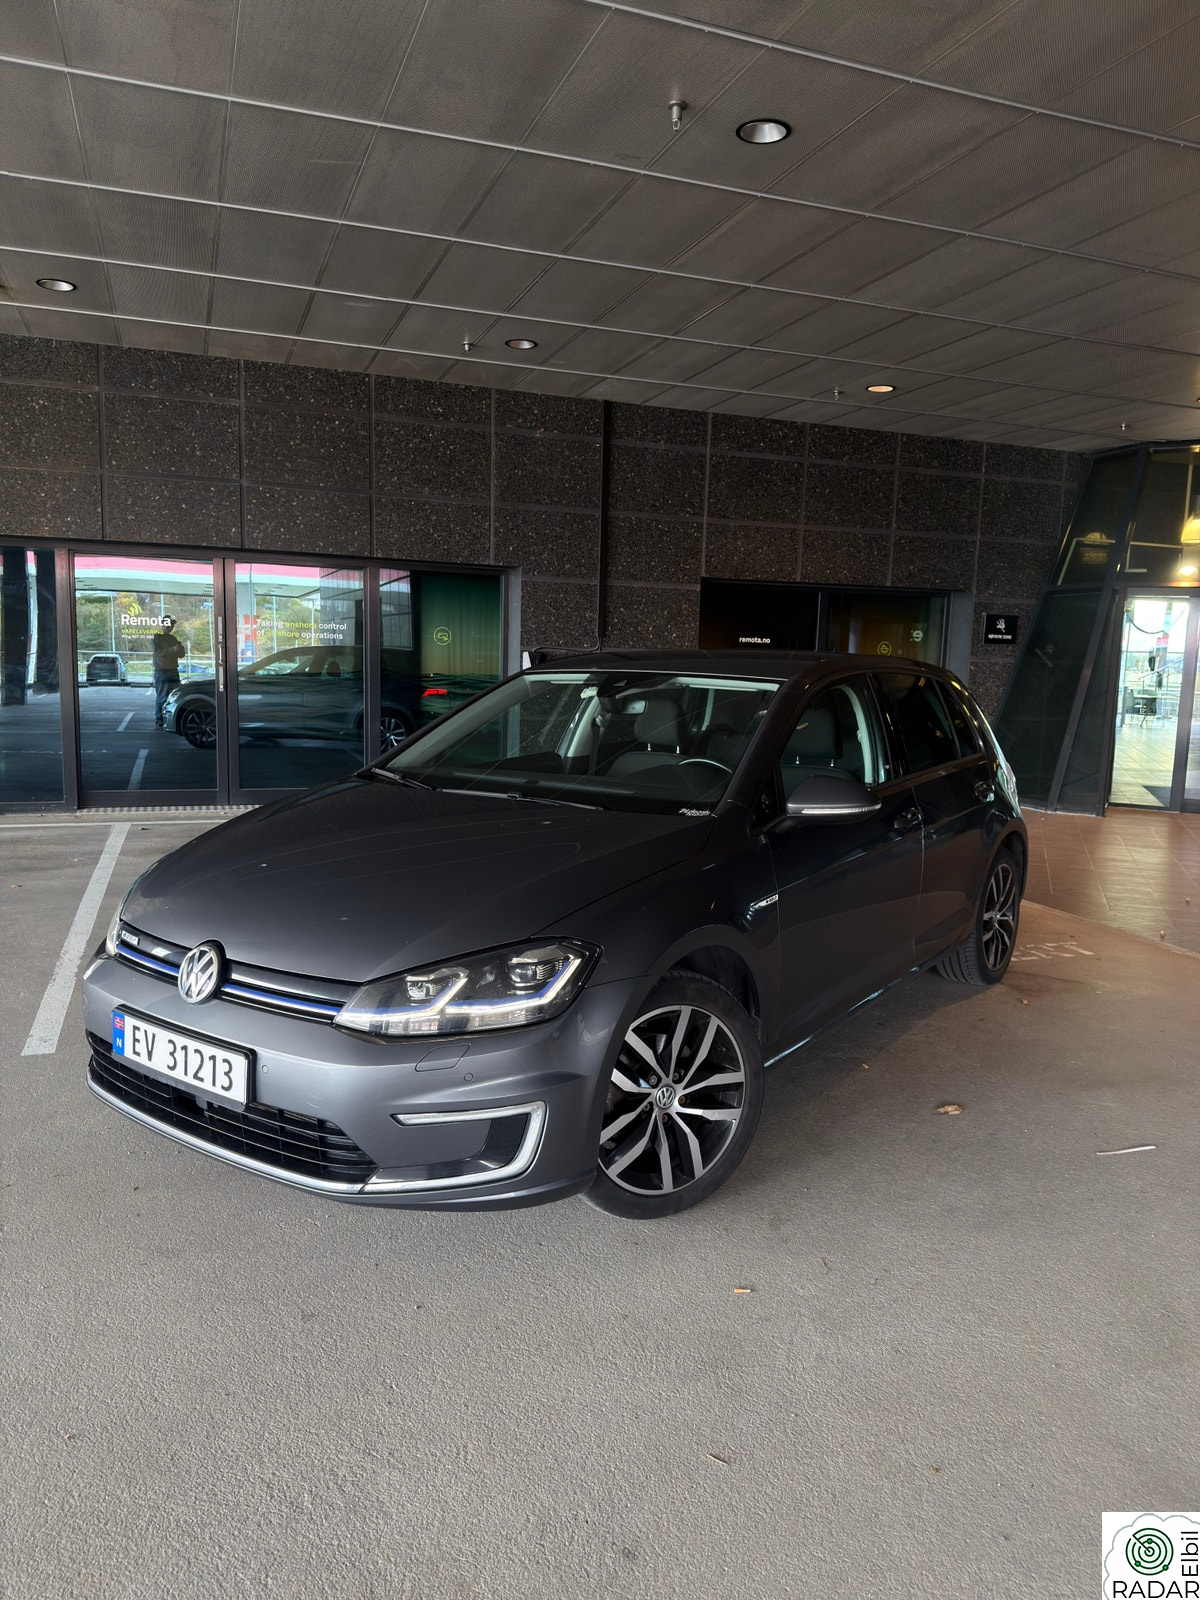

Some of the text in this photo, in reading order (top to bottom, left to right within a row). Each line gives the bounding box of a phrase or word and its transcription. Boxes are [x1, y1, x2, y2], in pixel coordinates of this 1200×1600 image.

[120, 614, 171, 627] Remota
[256, 619, 347, 631] Taking onshore control
[256, 629, 265, 637] of
[301, 632, 344, 640] operations
[116, 1037, 122, 1048] N
[132, 1024, 234, 1092] EV 31213
